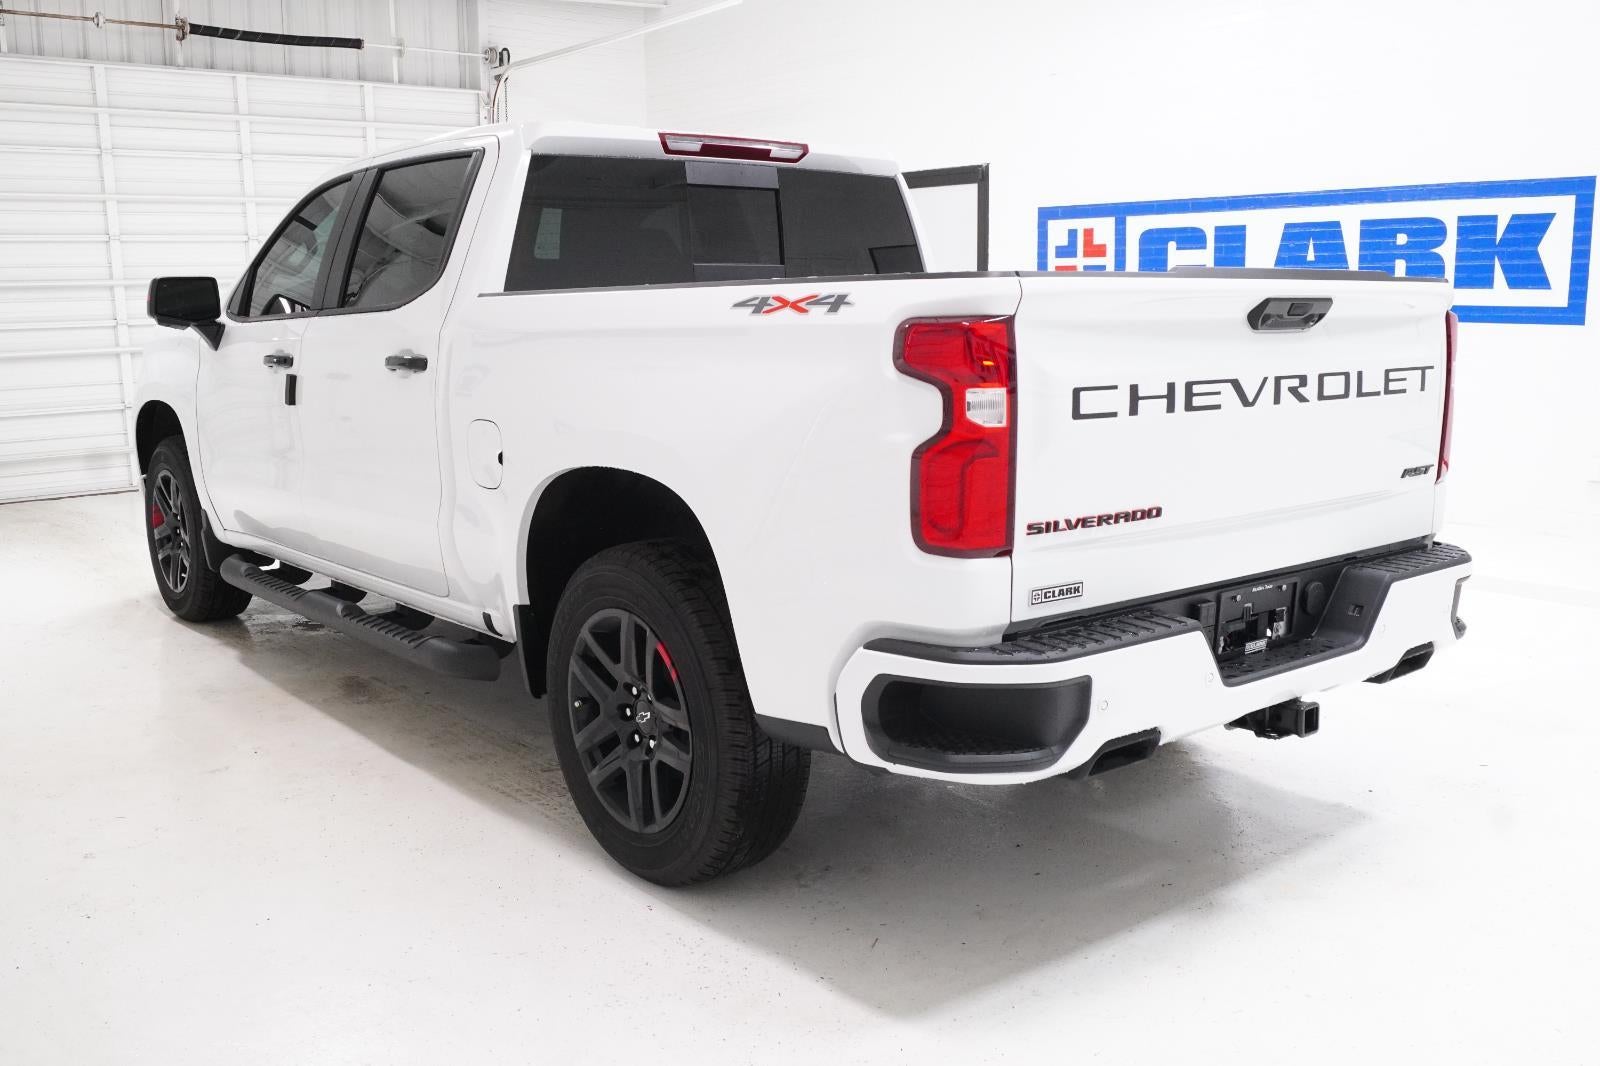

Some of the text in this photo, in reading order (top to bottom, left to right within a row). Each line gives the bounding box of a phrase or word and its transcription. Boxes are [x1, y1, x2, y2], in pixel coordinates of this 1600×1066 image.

[1138, 212, 1557, 290] CLARK
[1071, 366, 1434, 421] CHEVROLET
[1400, 464, 1434, 478] RST
[1026, 506, 1162, 535] SILVERADO
[1043, 586, 1081, 600] CLARK
